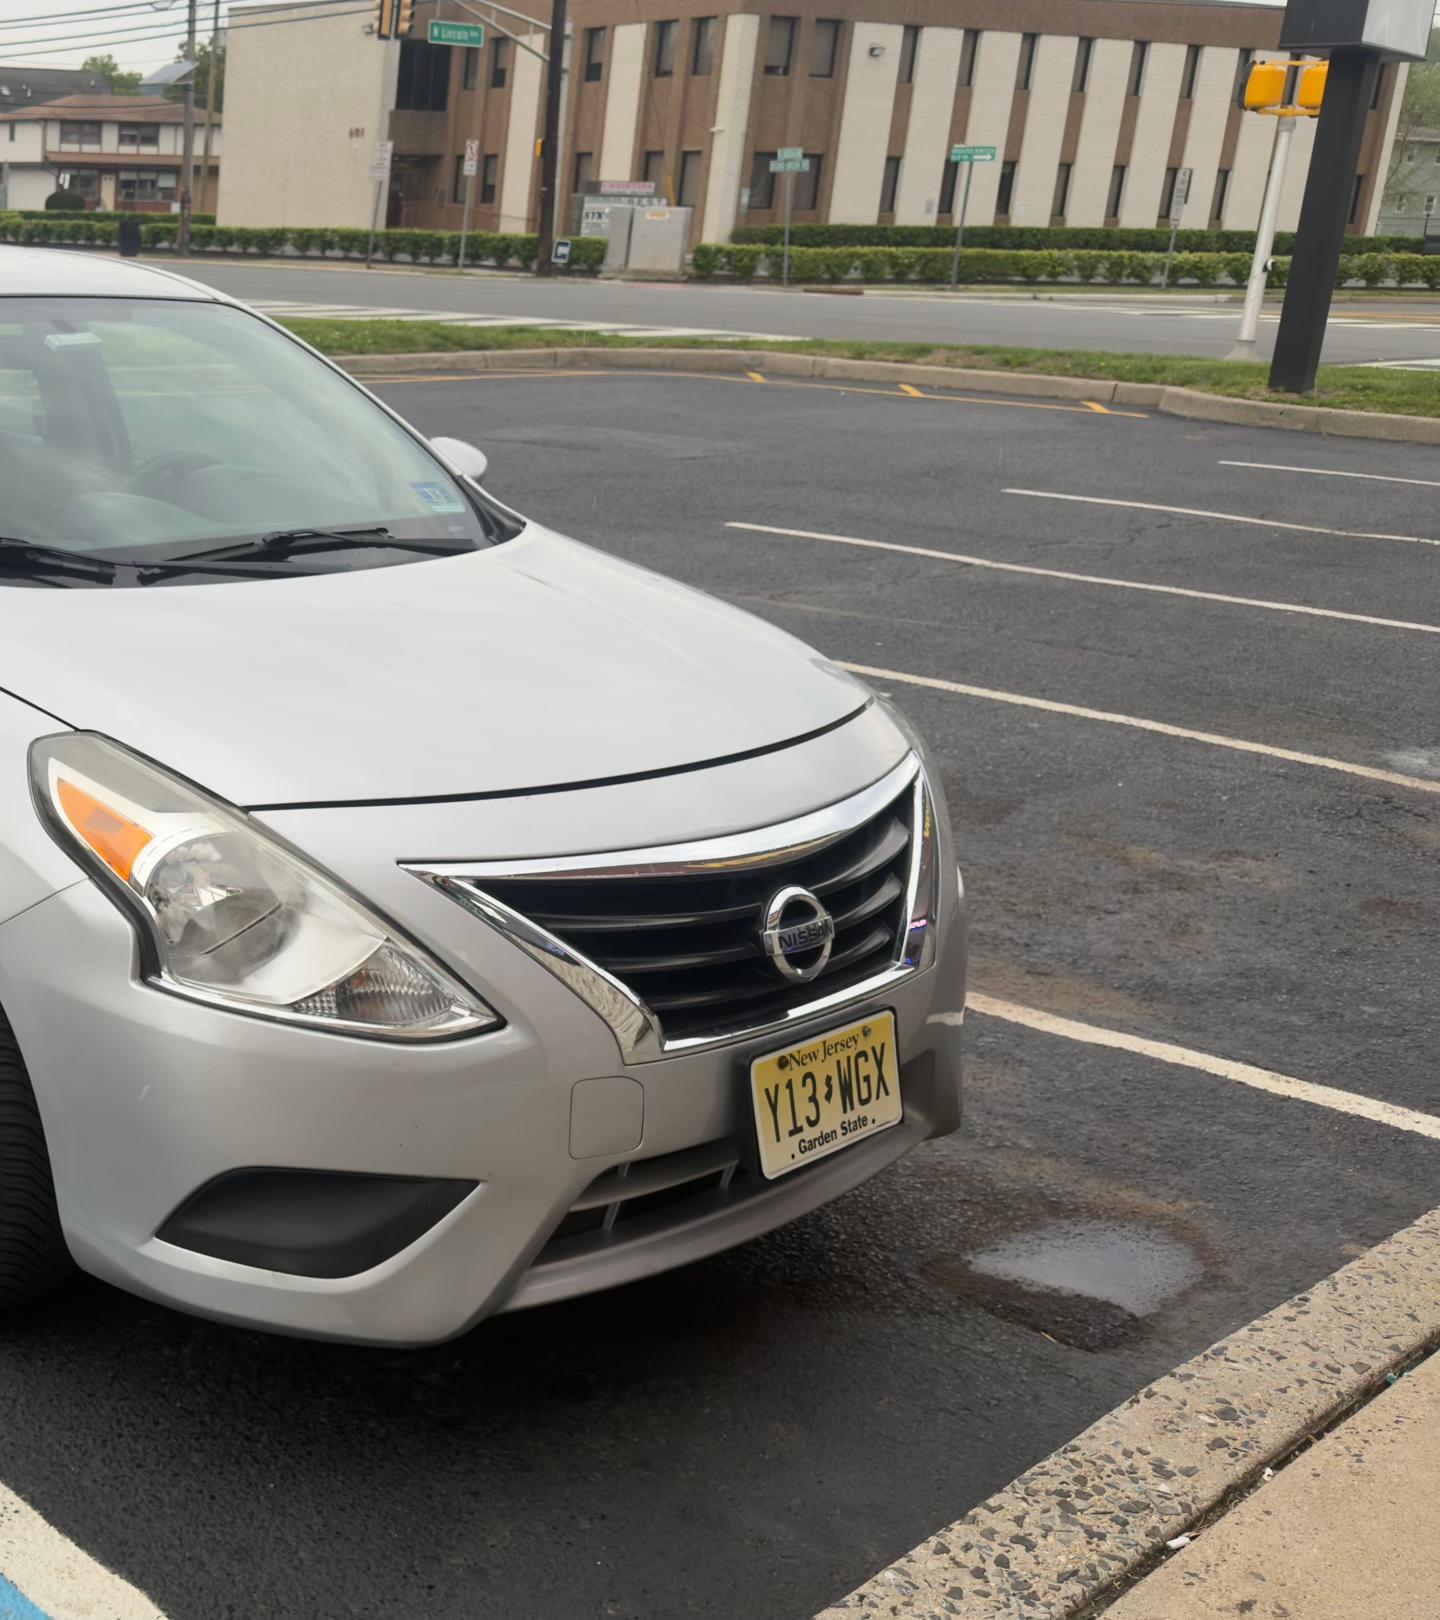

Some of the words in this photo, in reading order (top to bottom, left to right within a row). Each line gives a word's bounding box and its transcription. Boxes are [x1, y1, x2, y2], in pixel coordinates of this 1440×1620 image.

[441, 27, 469, 40] Lincoln
[778, 918, 833, 949] NISSAN
[789, 1048, 821, 1071] New
[821, 1033, 860, 1063] Jersey
[764, 1071, 821, 1143] Y13
[836, 1042, 890, 1115] WGX
[798, 1129, 838, 1155] Garden
[840, 1115, 869, 1136] State
